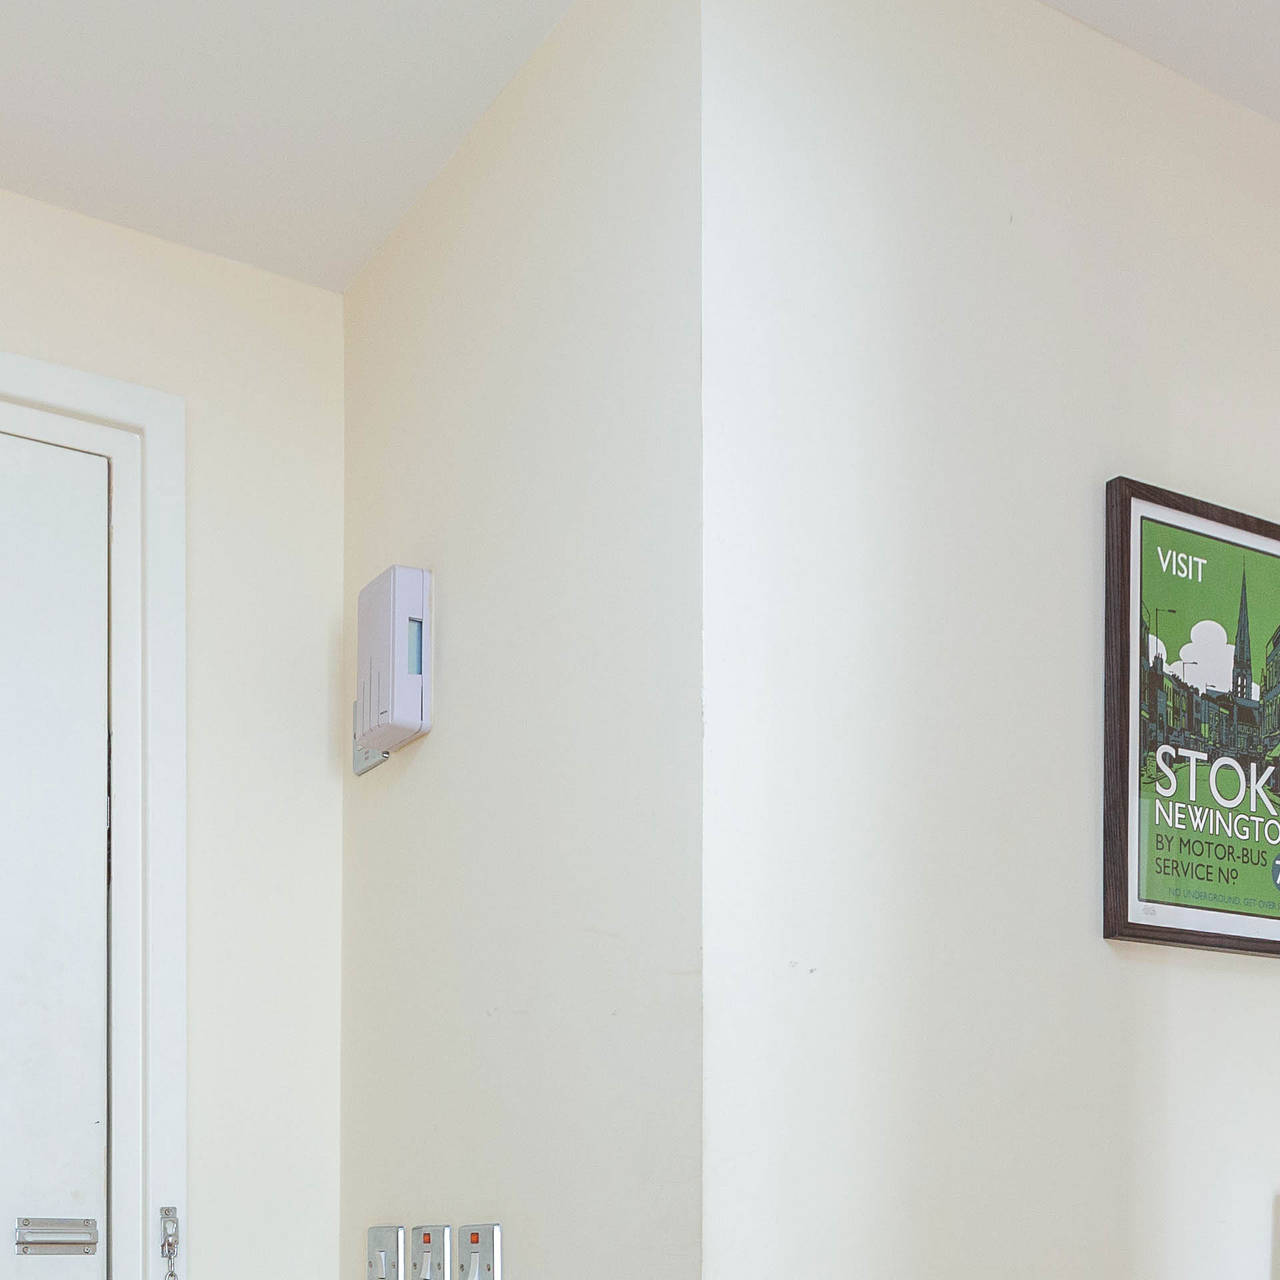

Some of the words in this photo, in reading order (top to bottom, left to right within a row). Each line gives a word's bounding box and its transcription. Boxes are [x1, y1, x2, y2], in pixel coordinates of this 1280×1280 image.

[1156, 546, 1207, 583] VISIT
[1155, 833, 1174, 852] BY
[1179, 837, 1268, 867] MOTOR-BUS
[1154, 857, 1214, 883] SERVICE
